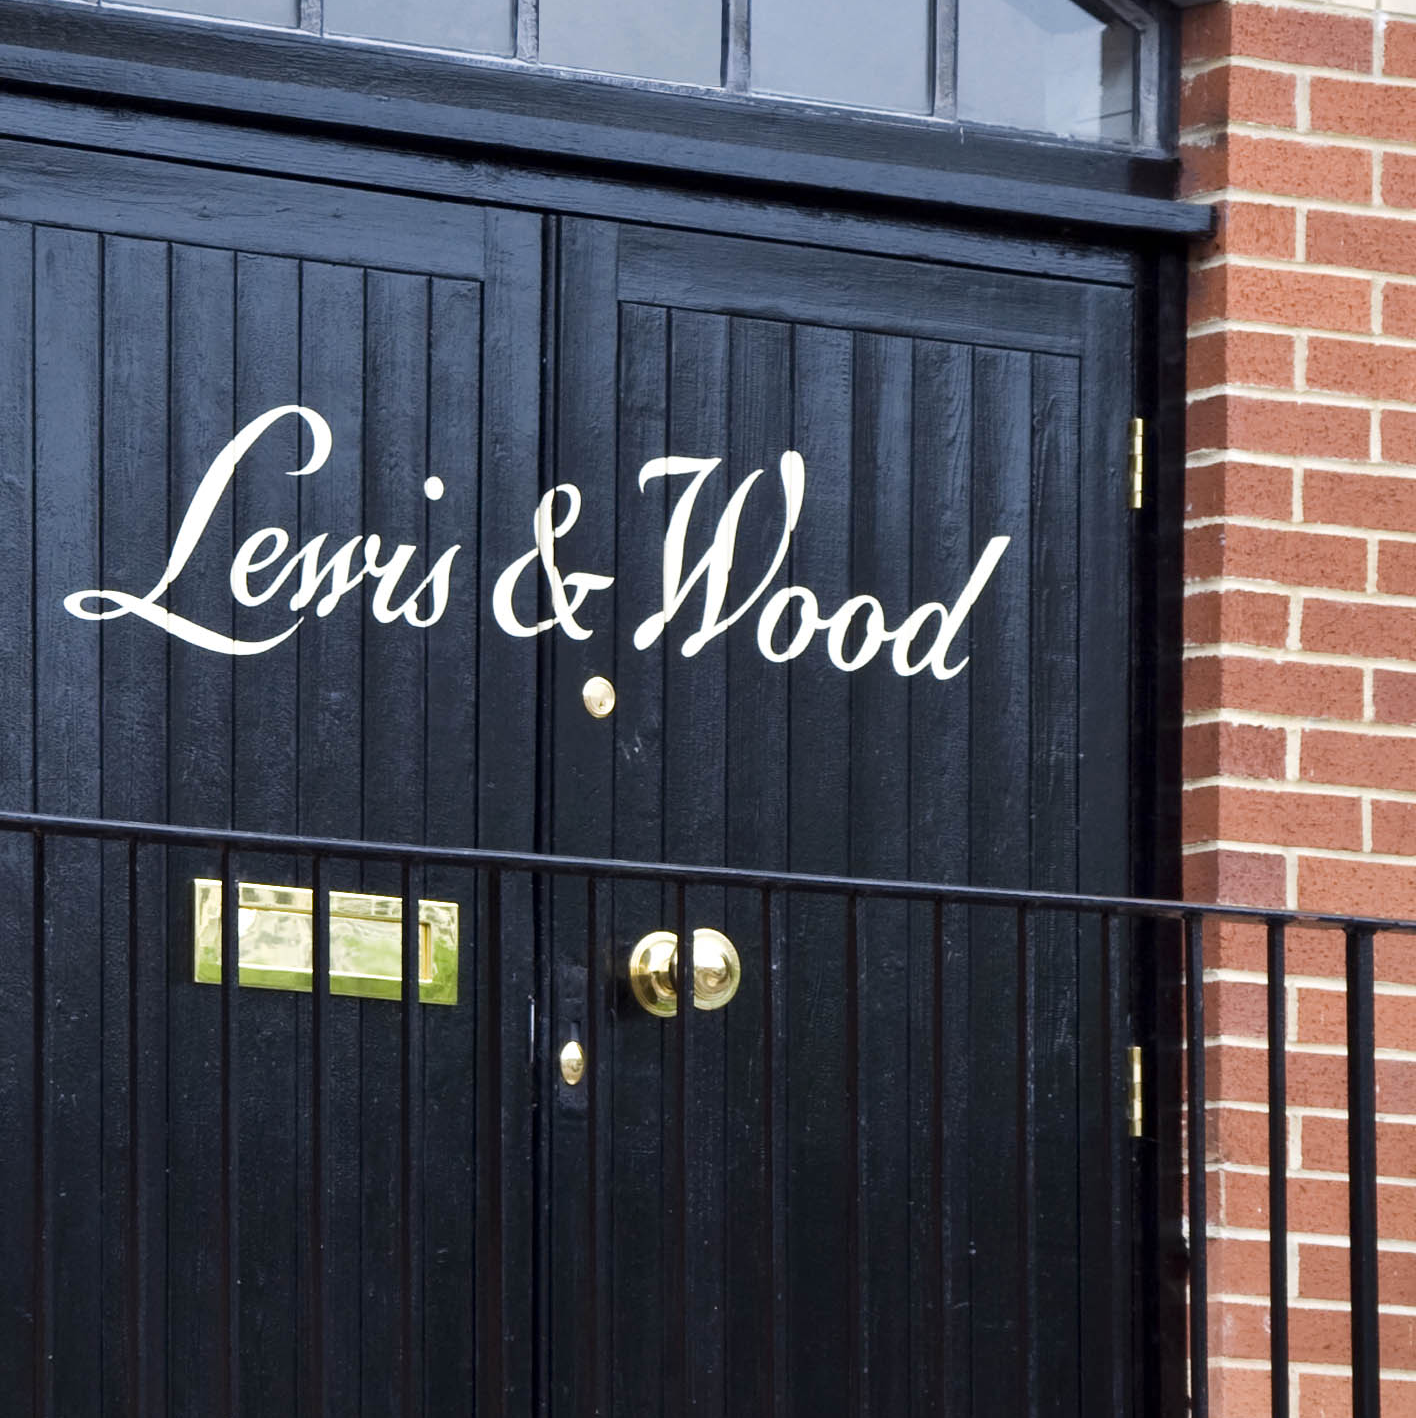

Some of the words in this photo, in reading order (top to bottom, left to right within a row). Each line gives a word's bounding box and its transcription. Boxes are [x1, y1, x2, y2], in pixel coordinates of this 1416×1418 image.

[63, 404, 462, 656] Lewis
[492, 483, 616, 642] &
[633, 449, 1012, 681] Wood
